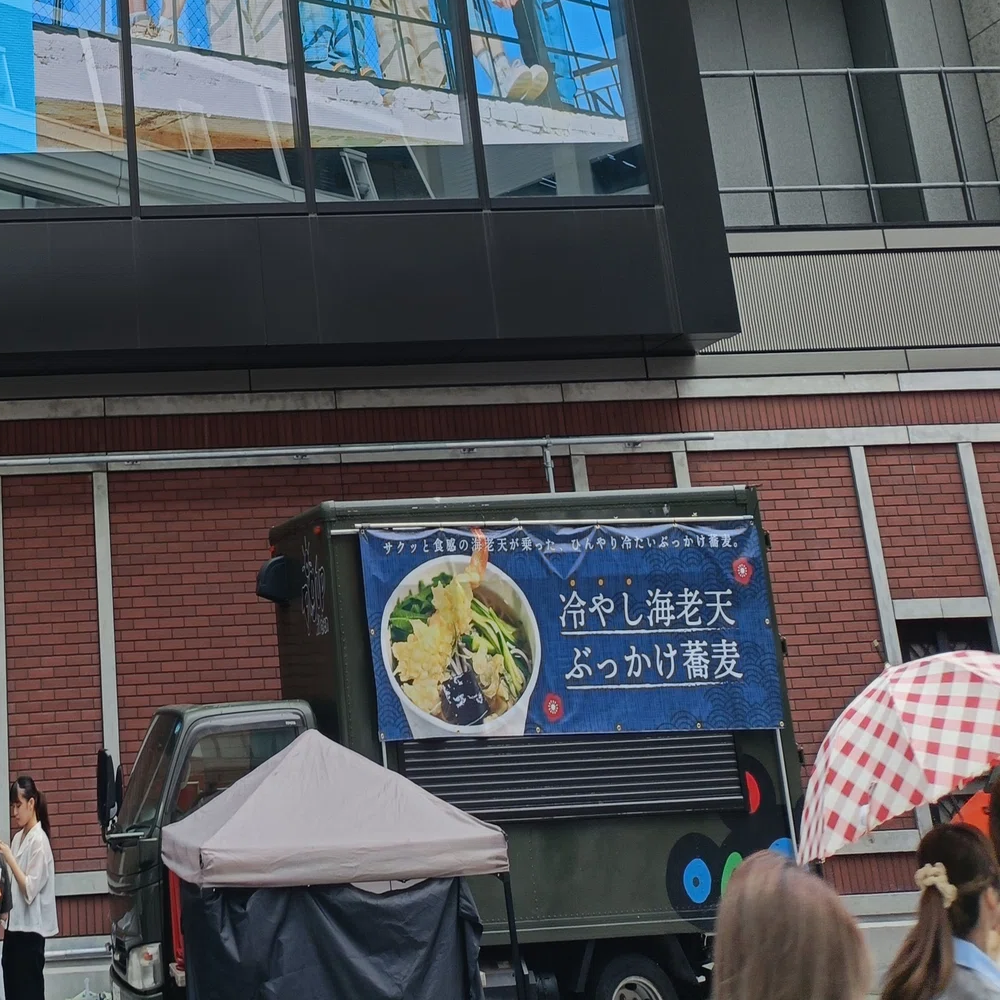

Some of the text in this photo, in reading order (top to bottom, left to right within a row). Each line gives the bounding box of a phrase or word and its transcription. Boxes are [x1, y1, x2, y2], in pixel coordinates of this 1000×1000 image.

[558, 587, 737, 630] 冷やし海老天
[564, 638, 744, 681] ぶっかけ蕎麦
